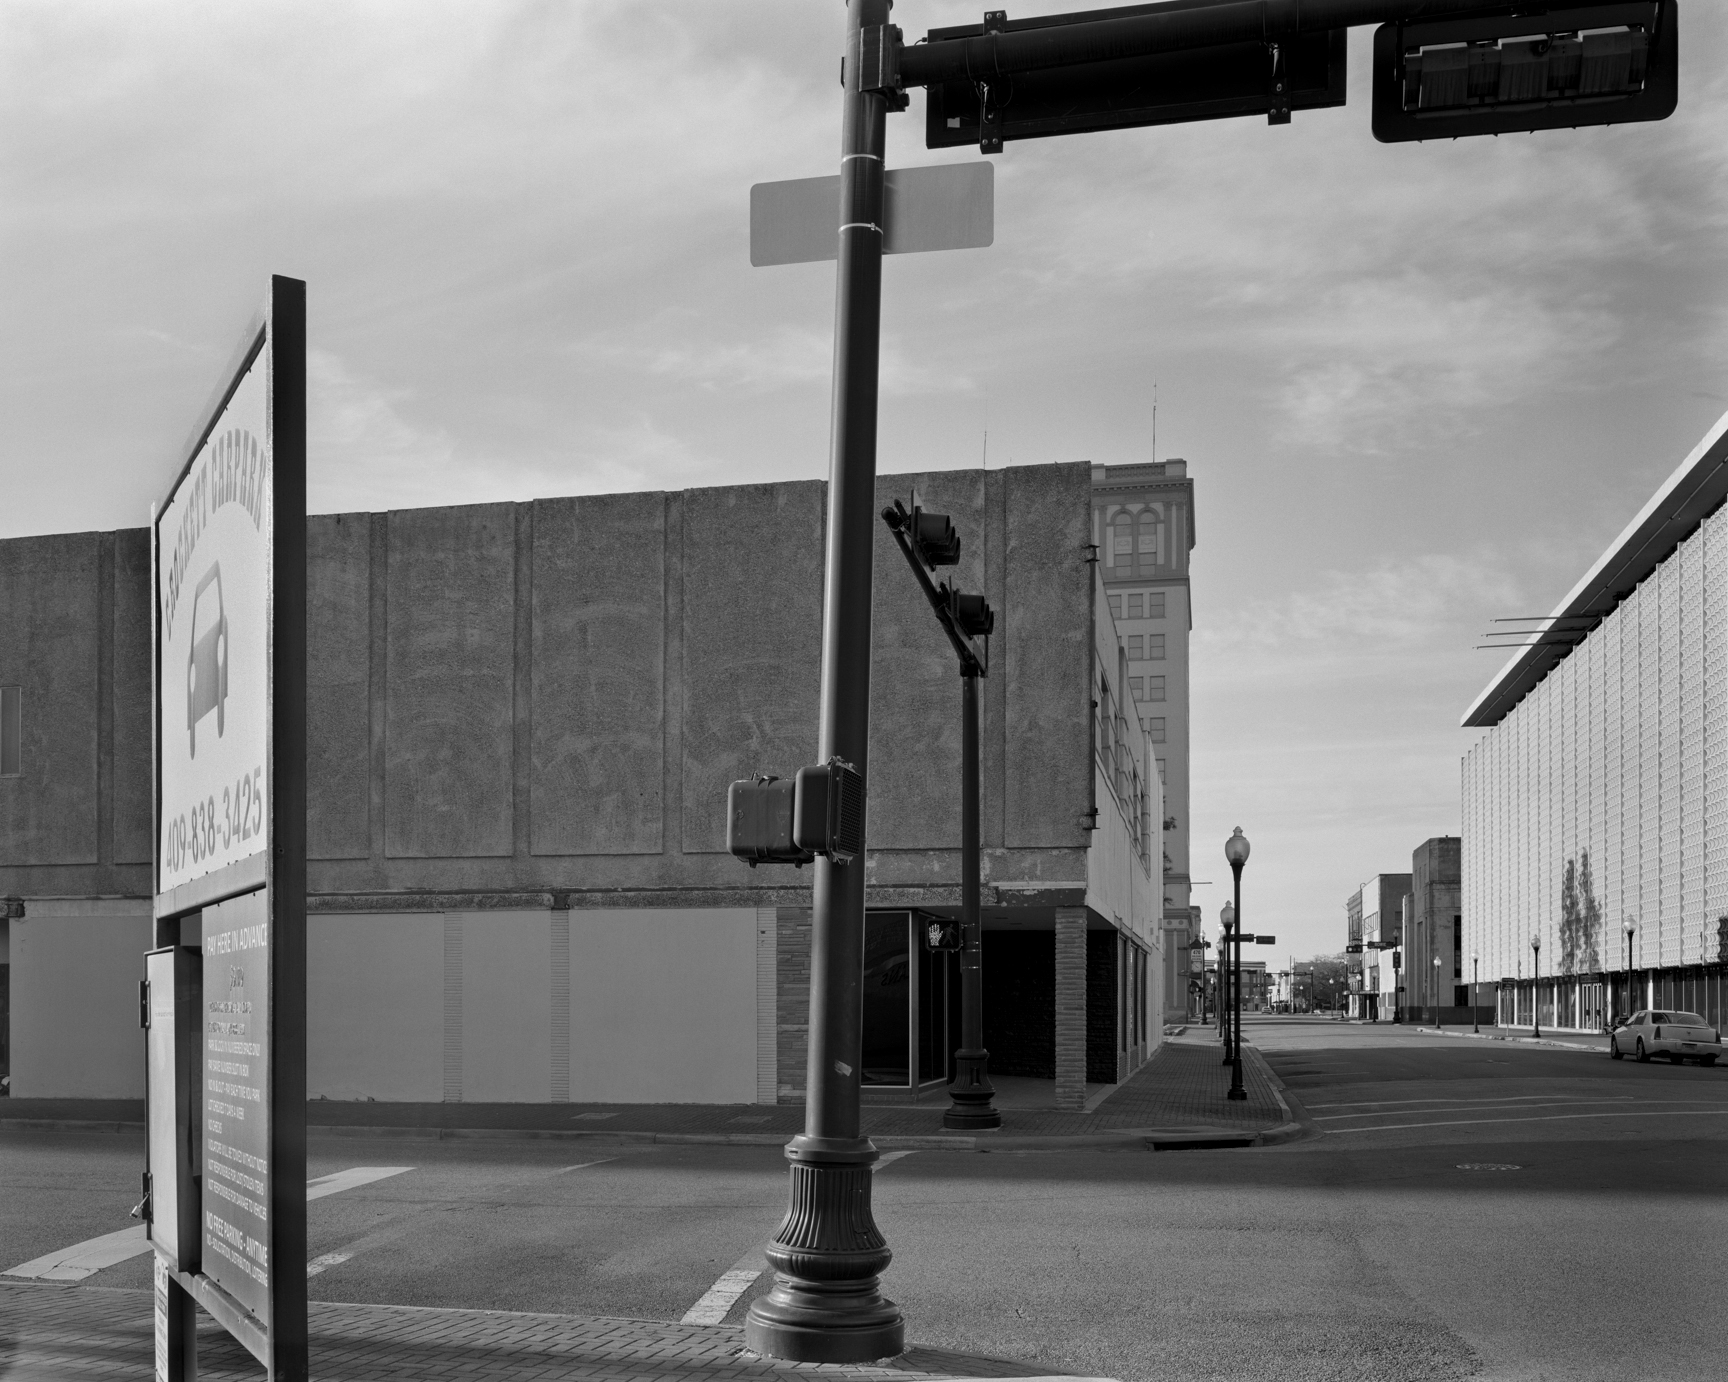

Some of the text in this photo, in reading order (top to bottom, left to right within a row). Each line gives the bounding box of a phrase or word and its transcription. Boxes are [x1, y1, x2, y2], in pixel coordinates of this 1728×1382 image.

[165, 428, 267, 642] CROCKETT CARPARK
[166, 764, 262, 874] 409-838-3425
[207, 925, 267, 955] PAY HERE IN ADVANCE
[228, 1042, 243, 1054] NUMBERED
[243, 1043, 252, 1055] SPACE
[221, 1062, 232, 1074] NUMBER
[213, 1100, 224, 1114] CHECKED
[236, 1107, 244, 1120] WEEK
[208, 1119, 222, 1134] NO CHECKS
[208, 1138, 221, 1154] VIOLATORS
[232, 1148, 242, 1164] TOWED
[243, 1153, 256, 1170] WITHOUT
[214, 1161, 230, 1178] RESPONSIBLE
[255, 1181, 264, 1196] ITEMS
[214, 1181, 230, 1200] RESPONSIBLE
[236, 1194, 248, 1210] DAMAGE
[253, 1203, 267, 1221] VEHICLES
[206, 1210, 213, 1229] NO
[214, 1214, 223, 1236] FREE
[224, 1221, 242, 1250] PARKING
[246, 1235, 267, 1268] ANYTIME
